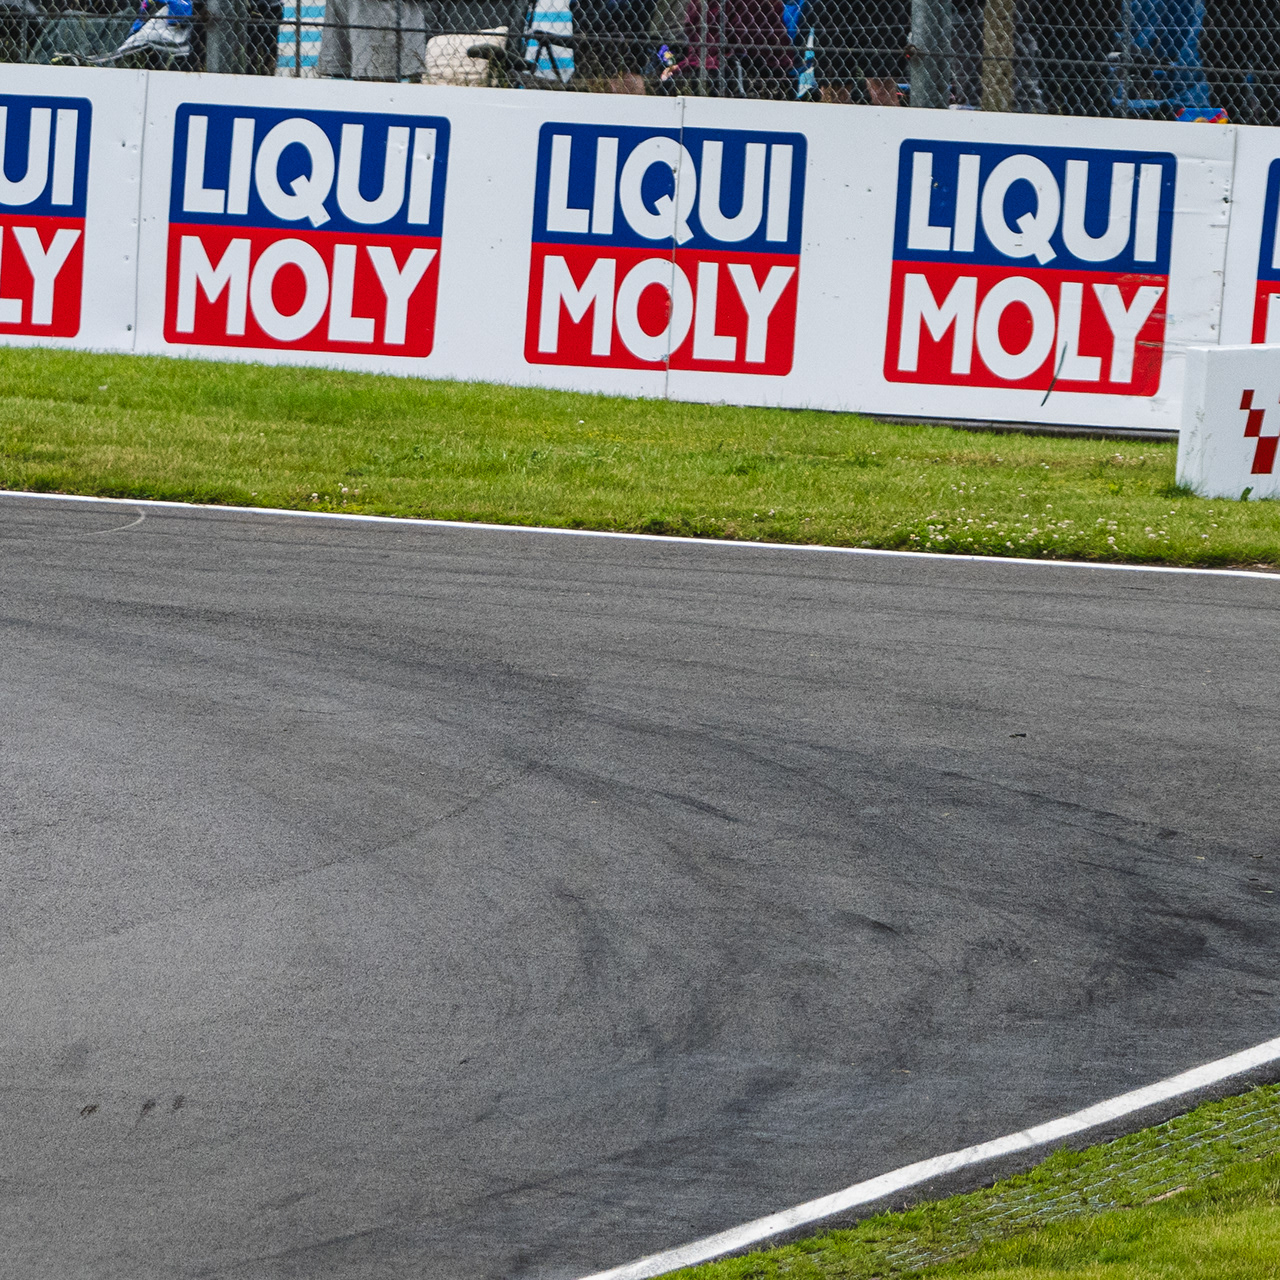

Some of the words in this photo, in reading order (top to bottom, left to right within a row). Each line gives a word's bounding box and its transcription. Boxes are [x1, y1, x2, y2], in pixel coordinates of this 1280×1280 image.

[183, 115, 437, 228] LIQUI
[546, 134, 794, 245] LIQUI
[907, 151, 1163, 265] LIQUI
[175, 235, 438, 345] MOLY
[538, 255, 796, 363] MOLY
[897, 273, 1166, 385] MOLY
